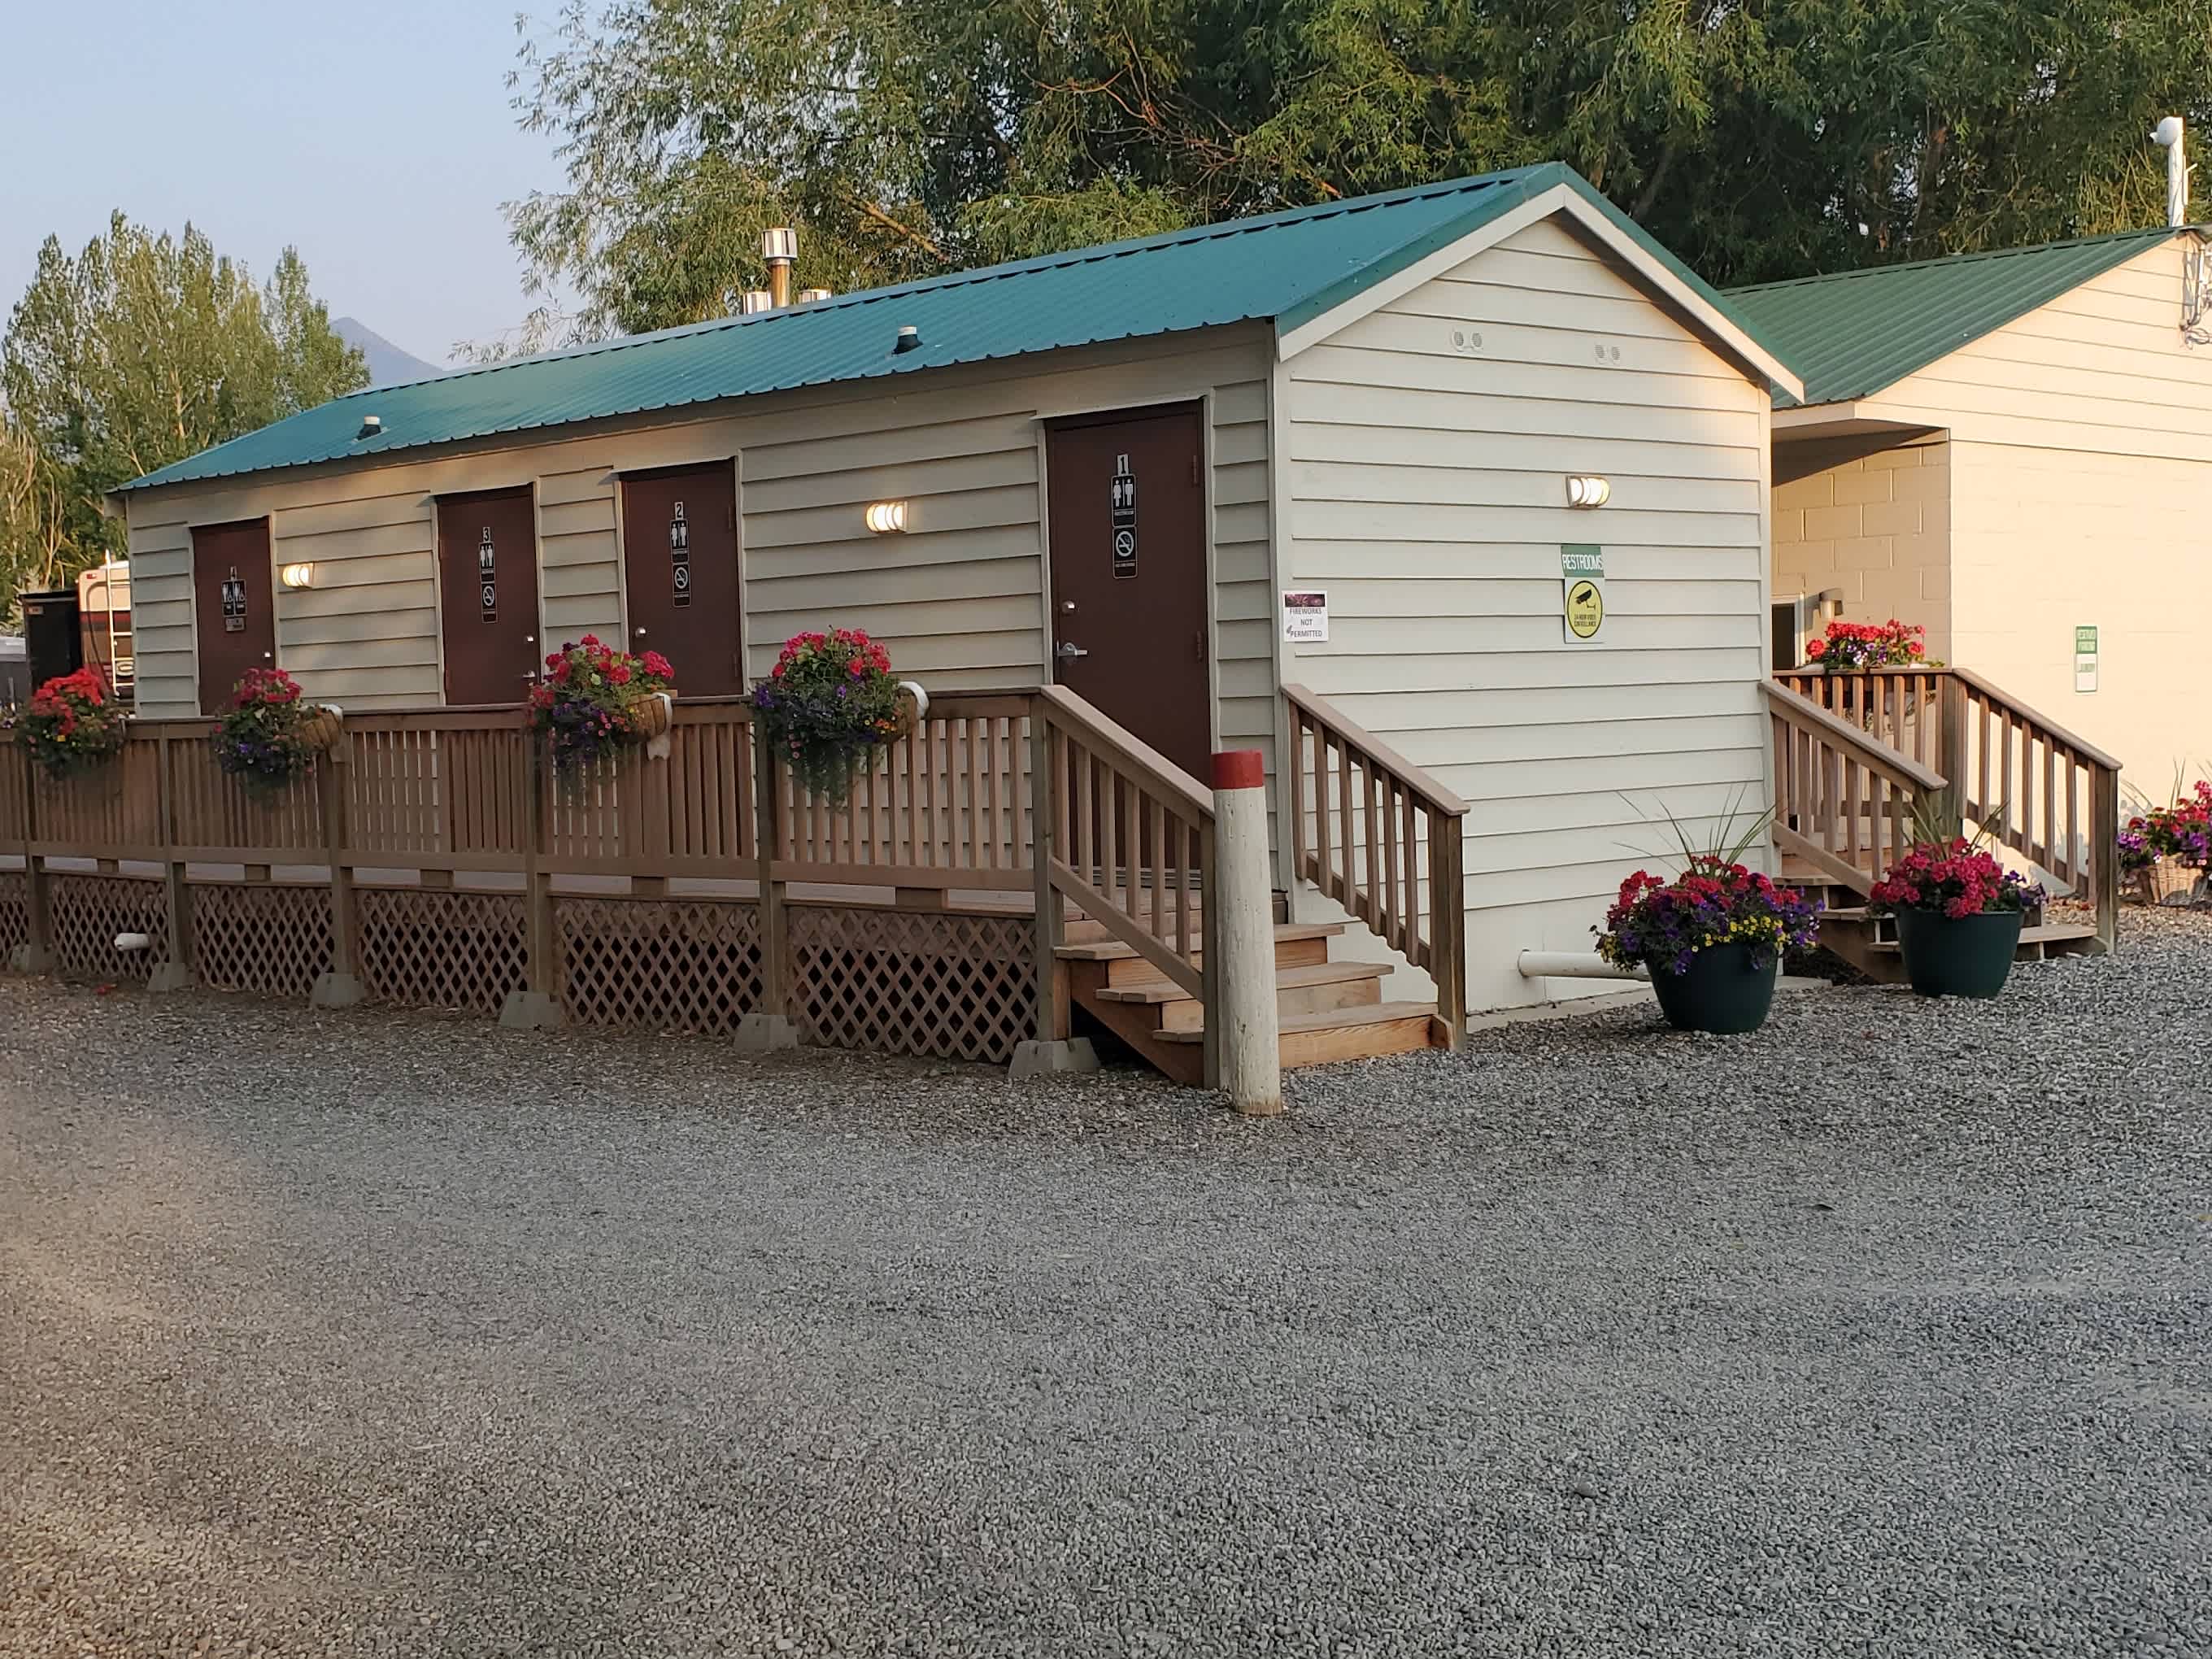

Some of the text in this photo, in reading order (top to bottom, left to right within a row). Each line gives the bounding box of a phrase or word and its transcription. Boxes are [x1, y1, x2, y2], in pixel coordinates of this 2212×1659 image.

[1120, 456, 1126, 474] 1
[676, 503, 682, 518] 2
[1561, 554, 1603, 571] RESTROOMS
[1290, 629, 1322, 638] PERMITTED
